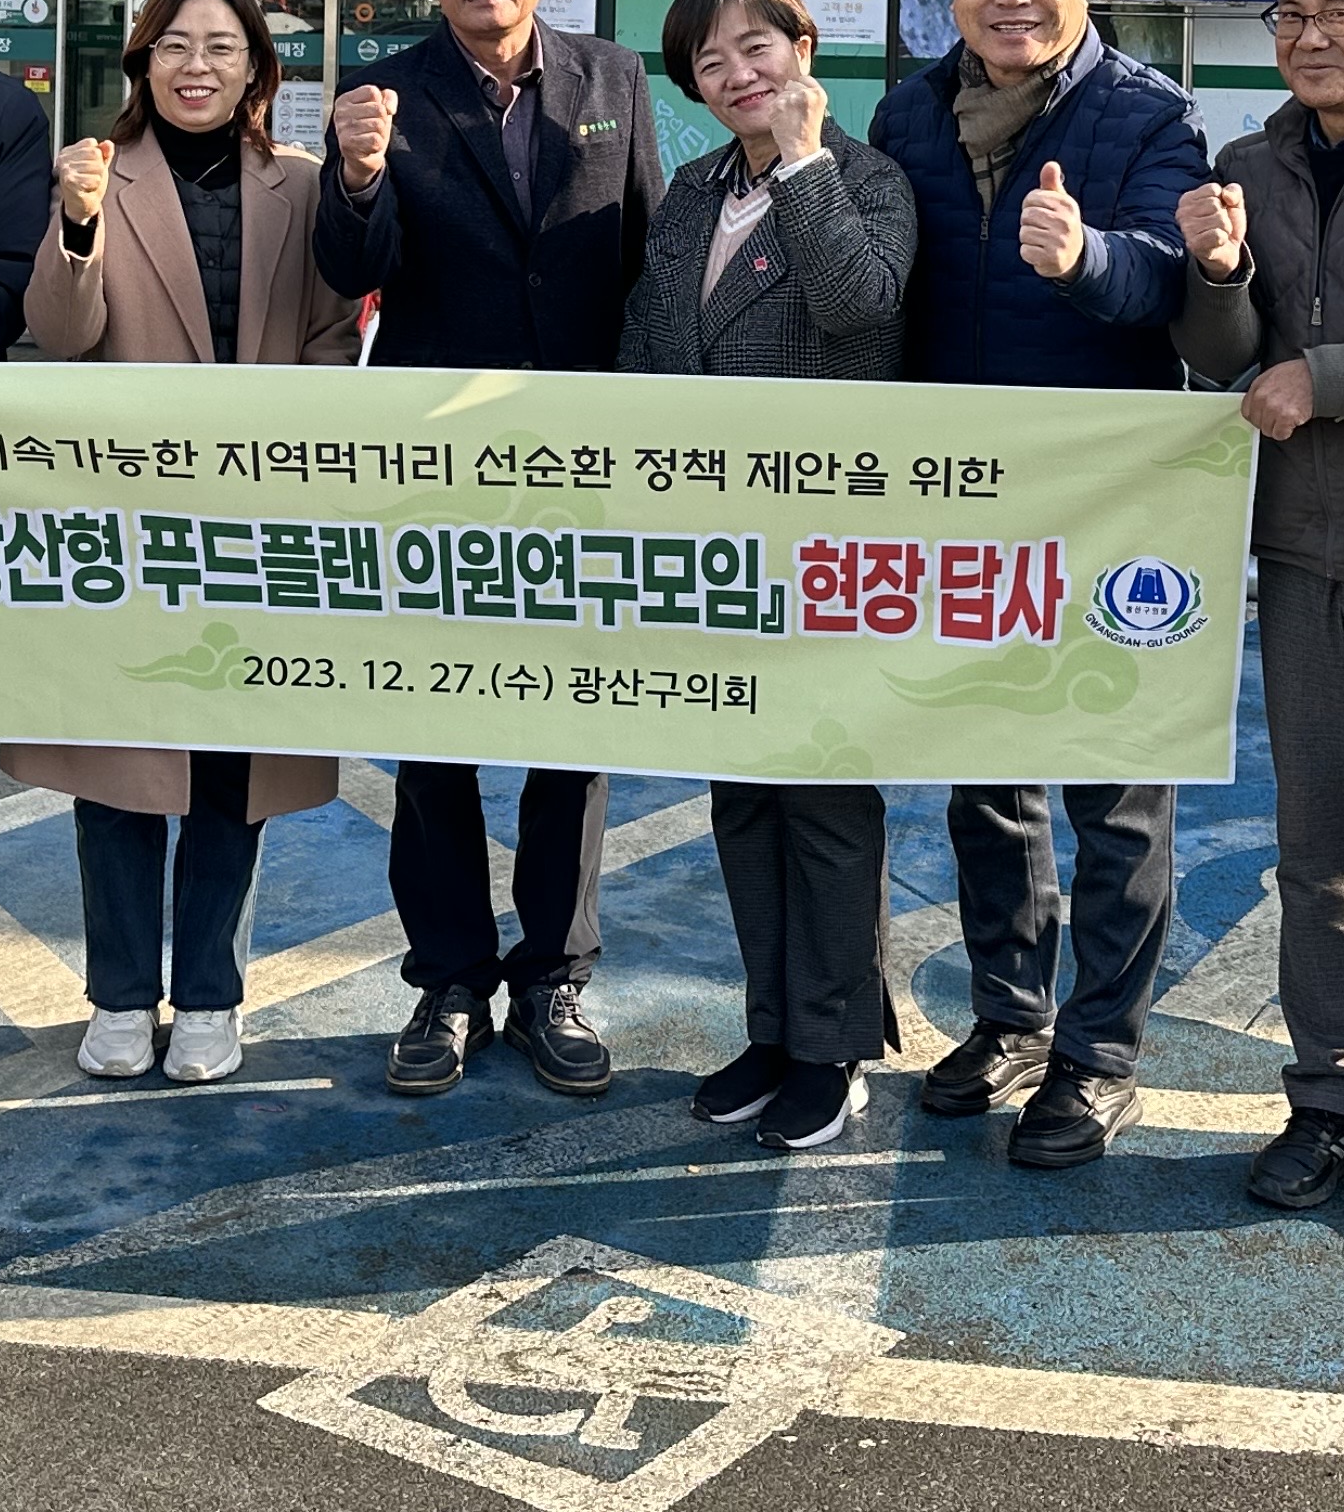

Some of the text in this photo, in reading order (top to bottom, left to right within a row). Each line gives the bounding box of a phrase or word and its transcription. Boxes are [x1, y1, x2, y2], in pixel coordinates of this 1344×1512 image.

[216, 439, 455, 487] 지역먹거리
[473, 443, 616, 491] 선순환
[633, 447, 728, 494] 정책
[746, 450, 889, 498] 제안을
[908, 455, 1005, 500] 위한
[139, 513, 384, 613] 푸드플랜
[396, 527, 785, 636] 의원연구모임』
[798, 537, 926, 636] 현장
[938, 539, 1065, 642] 답사
[1084, 612, 1209, 648] GWANGSAN-GU COUNCIL
[244, 655, 759, 716] 2023. 12. 27.(수) 광산구의회
